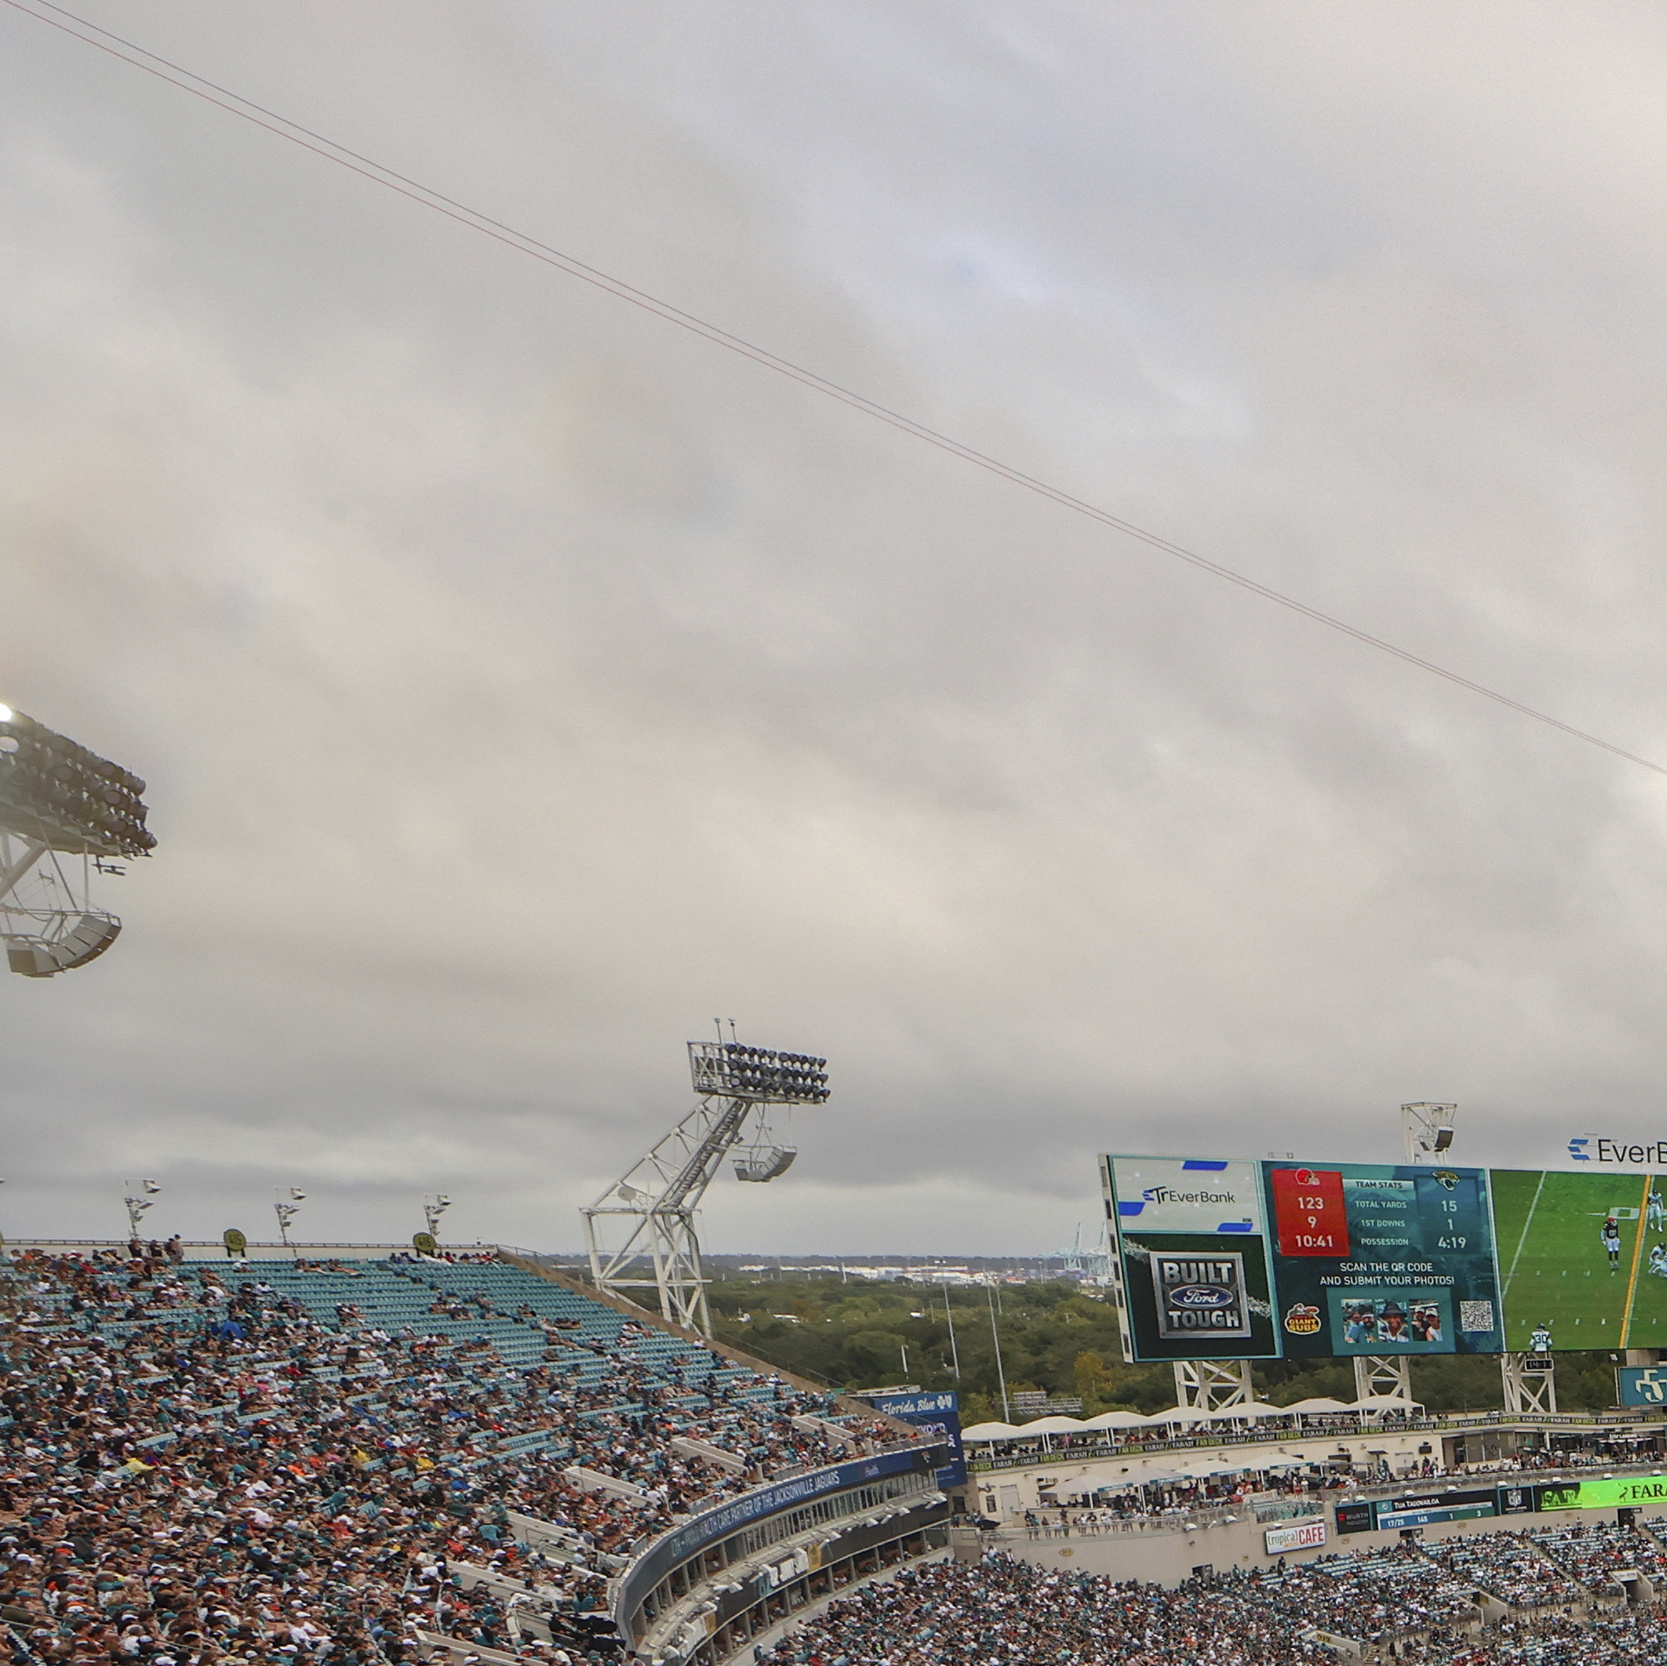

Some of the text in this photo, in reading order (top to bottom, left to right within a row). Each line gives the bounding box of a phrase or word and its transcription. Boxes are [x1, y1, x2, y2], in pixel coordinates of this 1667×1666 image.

[1355, 1181, 1403, 1190] TEAM STATS
[1169, 1190, 1236, 1204] EverBank
[1297, 1197, 1458, 1212] 123 TOTAL YARDS 15
[1307, 1216, 1454, 1230] 9 1ST DOWNS 1
[1295, 1234, 1466, 1249] 10:41 POSSESSION 4:19
[1162, 1261, 1233, 1284] BUILT
[1340, 1262, 1433, 1273] SCAN THE QR CODE
[1320, 1276, 1455, 1287] AND SUBMIT YOUR PHOTOS!
[1182, 1289, 1219, 1305] Ford
[1167, 1309, 1239, 1328] TOUGH
[881, 1398, 937, 1416] Florida Blue
[1394, 1500, 1406, 1509] TUA
[1298, 1526, 1324, 1545] CAFE
